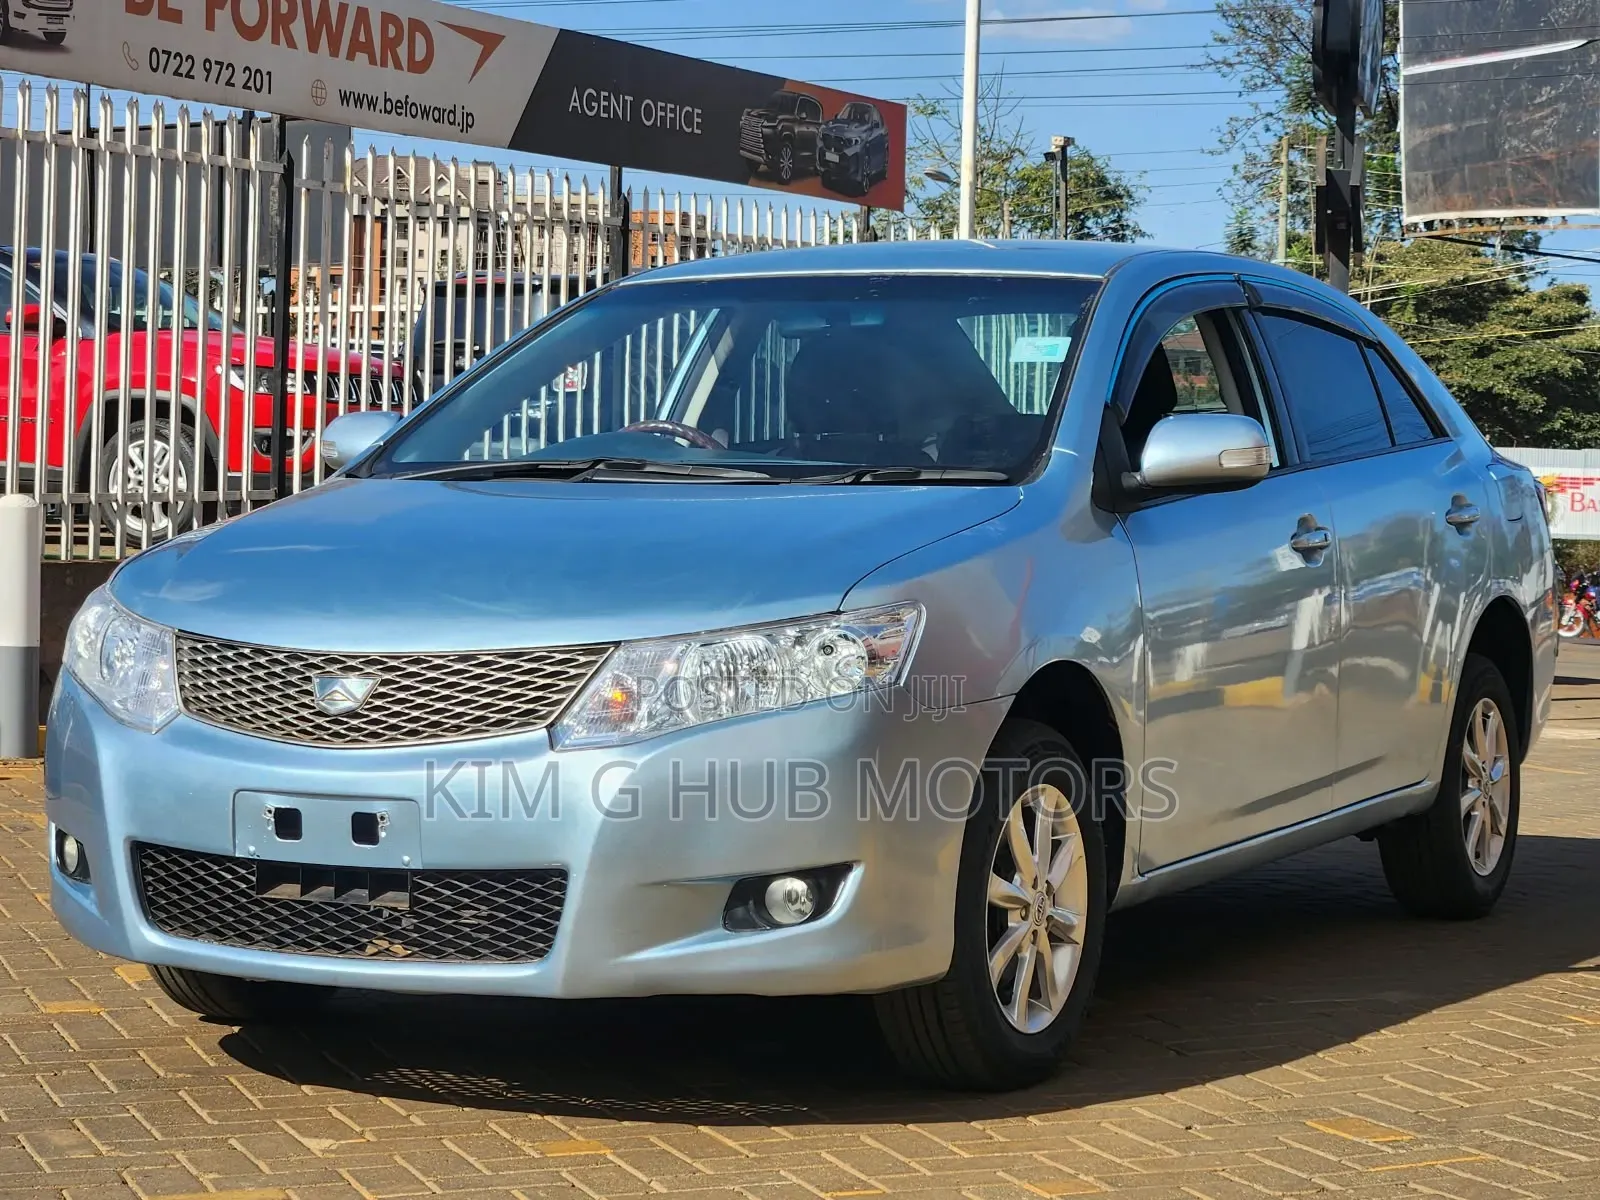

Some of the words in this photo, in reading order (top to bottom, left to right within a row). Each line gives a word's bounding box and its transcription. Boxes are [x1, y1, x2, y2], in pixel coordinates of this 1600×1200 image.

[149, 47, 195, 80] 0722
[203, 58, 236, 88] 972
[242, 66, 272, 95] 201
[338, 89, 475, 134] www.befoward.jp
[568, 86, 634, 122] AGENT
[641, 99, 702, 135] OFFICE
